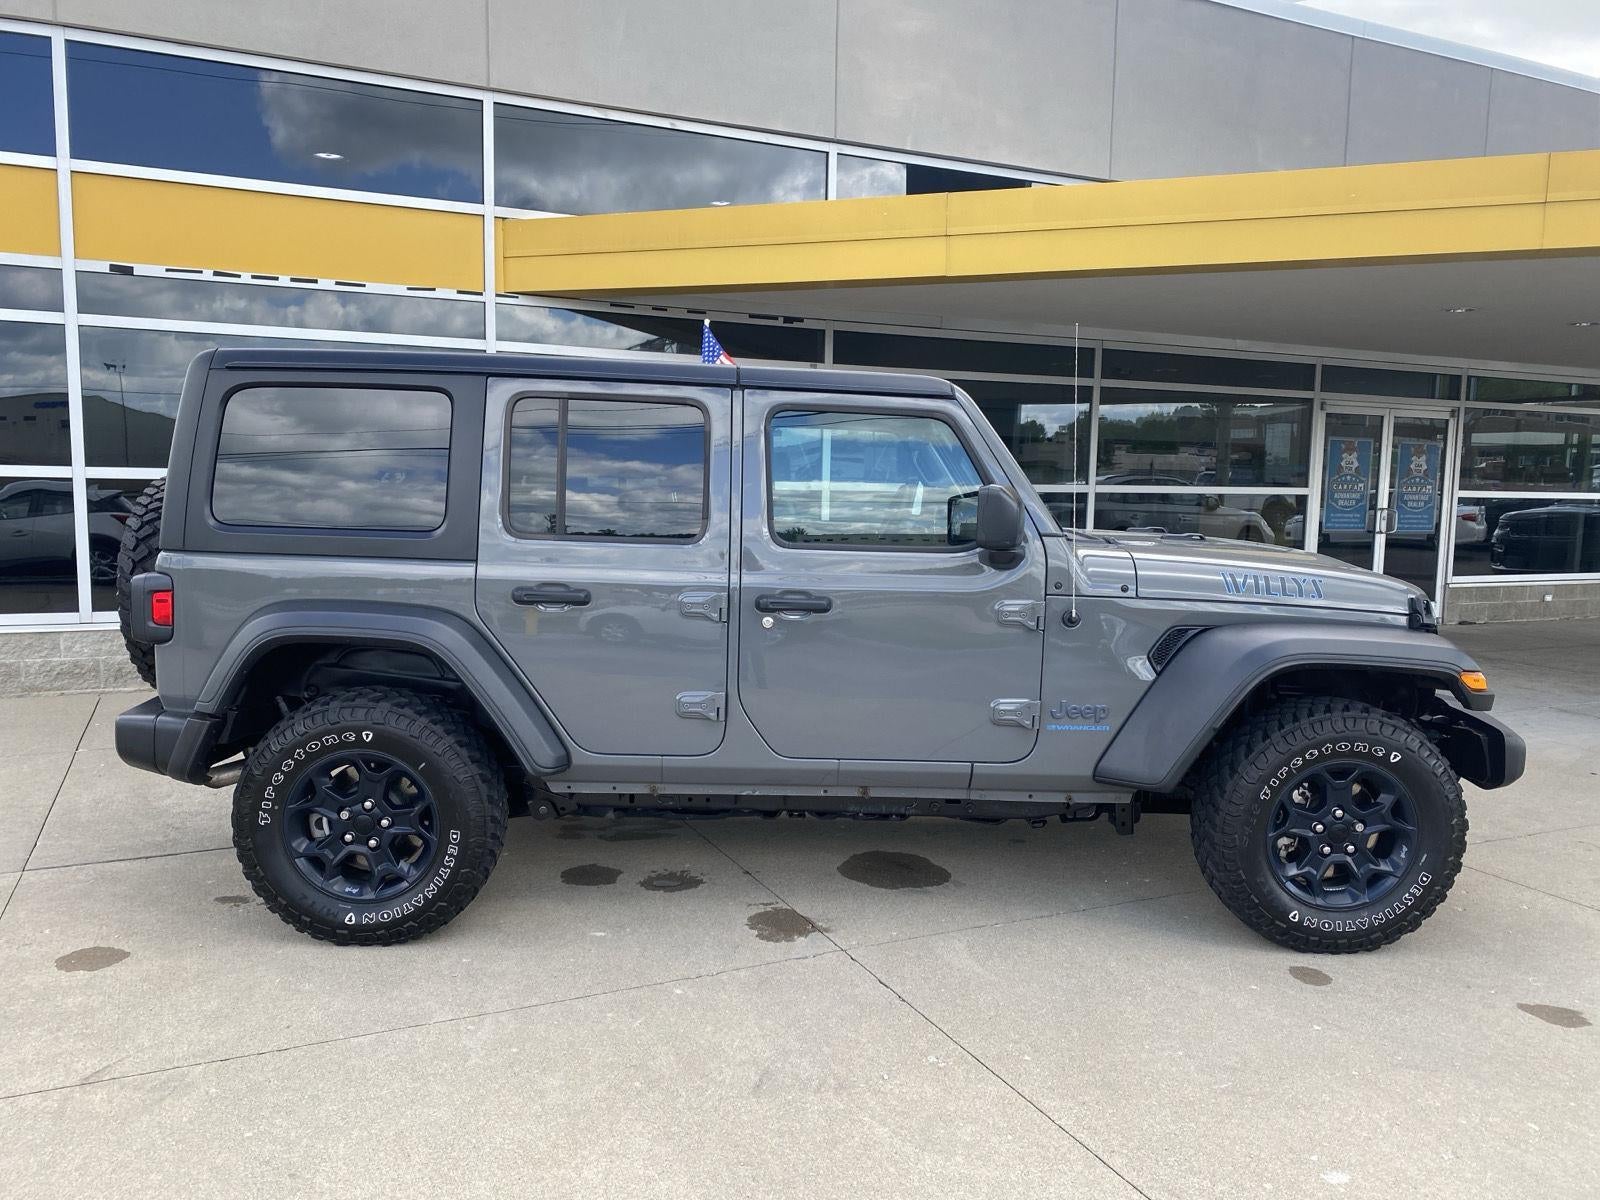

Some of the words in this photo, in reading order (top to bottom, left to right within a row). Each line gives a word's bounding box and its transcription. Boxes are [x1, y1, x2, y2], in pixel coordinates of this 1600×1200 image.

[1220, 572, 1323, 599] WILLYS
[1051, 700, 1110, 723] Jeep
[1056, 724, 1110, 732] WRANGLER
[259, 731, 356, 825] Firestone
[1260, 742, 1385, 800] Firestone
[363, 830, 460, 925] DESTINATION
[1303, 871, 1432, 932] DESTINATION
